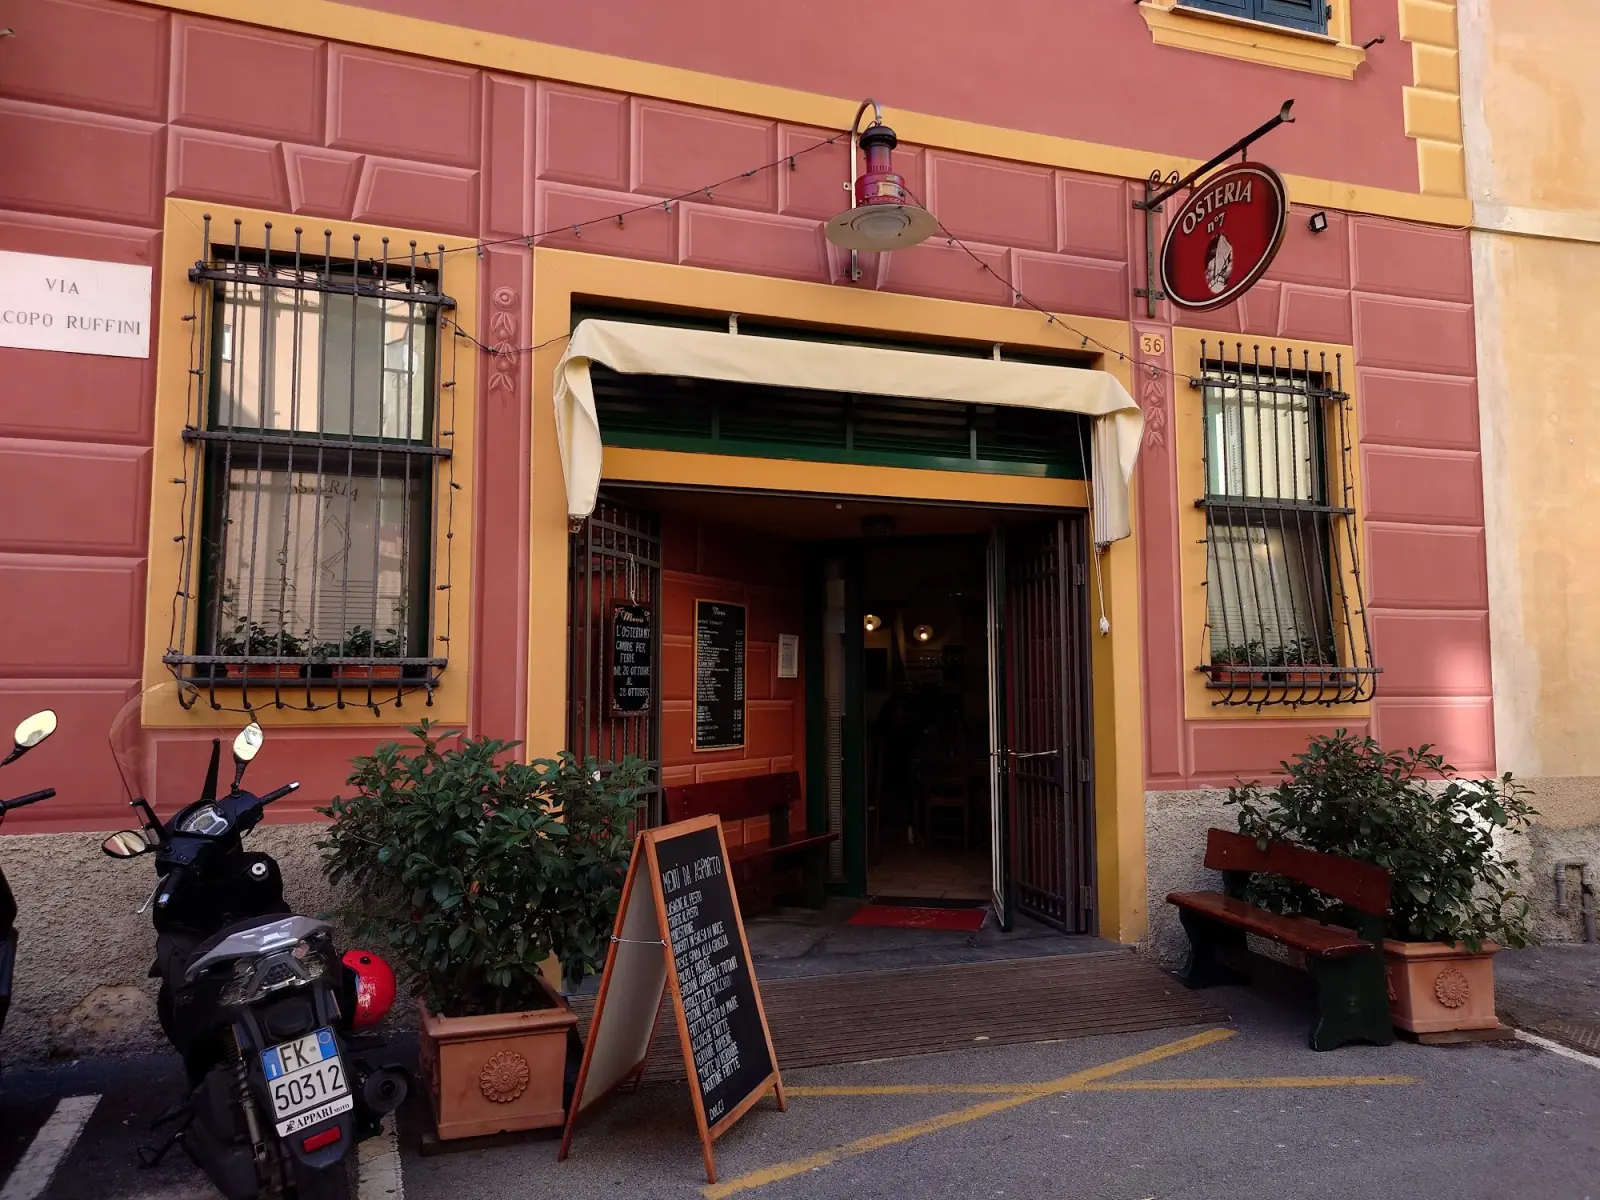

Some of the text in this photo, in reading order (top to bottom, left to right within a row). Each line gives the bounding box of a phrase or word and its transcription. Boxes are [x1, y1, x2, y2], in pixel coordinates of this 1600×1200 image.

[1182, 180, 1252, 235] OSTERIA
[45, 277, 80, 295] VIA
[0, 310, 141, 335] COPO RUFFINI
[1143, 337, 1162, 353] 36
[620, 652, 636, 663] FERIE
[635, 641, 646, 653] PER
[622, 665, 629, 676] 20
[626, 676, 633, 686] AL
[619, 687, 627, 697] 28
[682, 865, 692, 886] DA
[694, 856, 721, 882] ASPORTO
[689, 890, 702, 906] PESTO
[686, 905, 699, 921] PESTO
[694, 927, 707, 946] SALSA
[676, 953, 690, 971] PESCE
[701, 941, 712, 957] ALLA
[711, 934, 729, 953] GRIGLIA
[678, 967, 692, 986] POLPO
[694, 956, 712, 976] PATATE
[688, 995, 739, 1039] FRITTO MISTO DI MARE
[711, 1017, 730, 1039] FRITTE
[280, 1039, 310, 1073] FK
[702, 1055, 740, 1096] PATATINE FRITTE
[275, 1064, 344, 1111] 50312
[297, 1106, 334, 1129] APPARI
[709, 1099, 725, 1121] DOLCI
